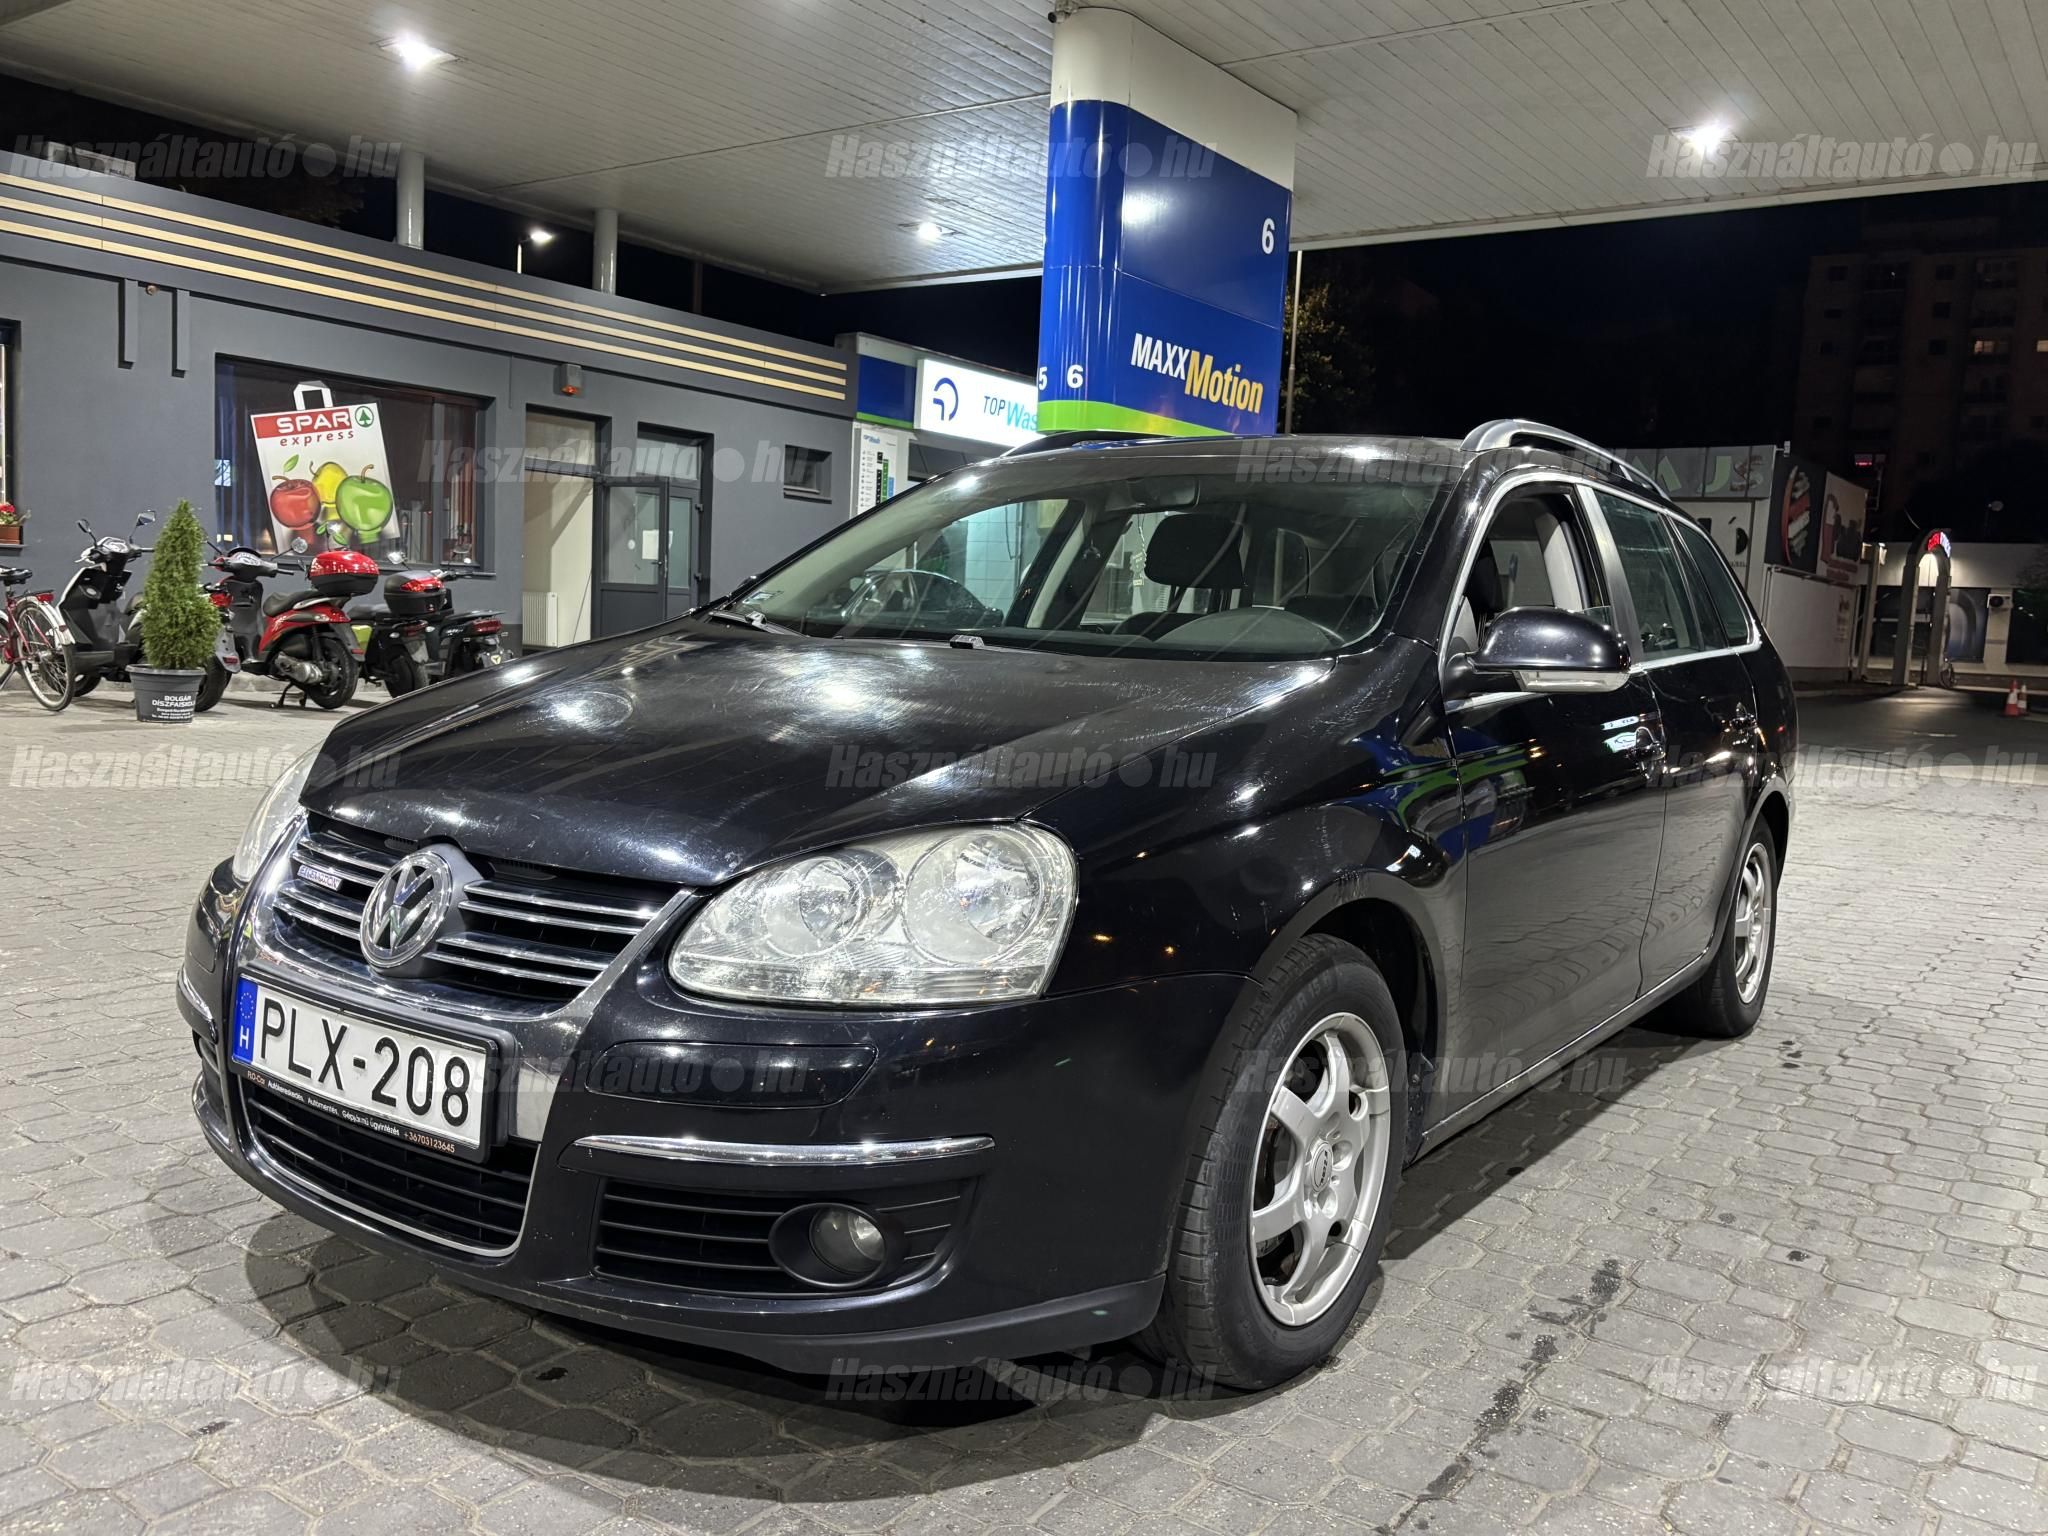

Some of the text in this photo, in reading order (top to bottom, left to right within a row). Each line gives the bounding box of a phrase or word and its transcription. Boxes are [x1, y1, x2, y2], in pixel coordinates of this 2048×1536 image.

[1261, 217, 1276, 255] 6
[1038, 366, 1048, 391] 5
[1066, 364, 1084, 389] 6
[276, 411, 351, 434] SPAR
[279, 430, 355, 447] express
[239, 1025, 250, 1050] H
[260, 996, 470, 1128] PLX-208
[404, 1131, 456, 1153] +36703123645
